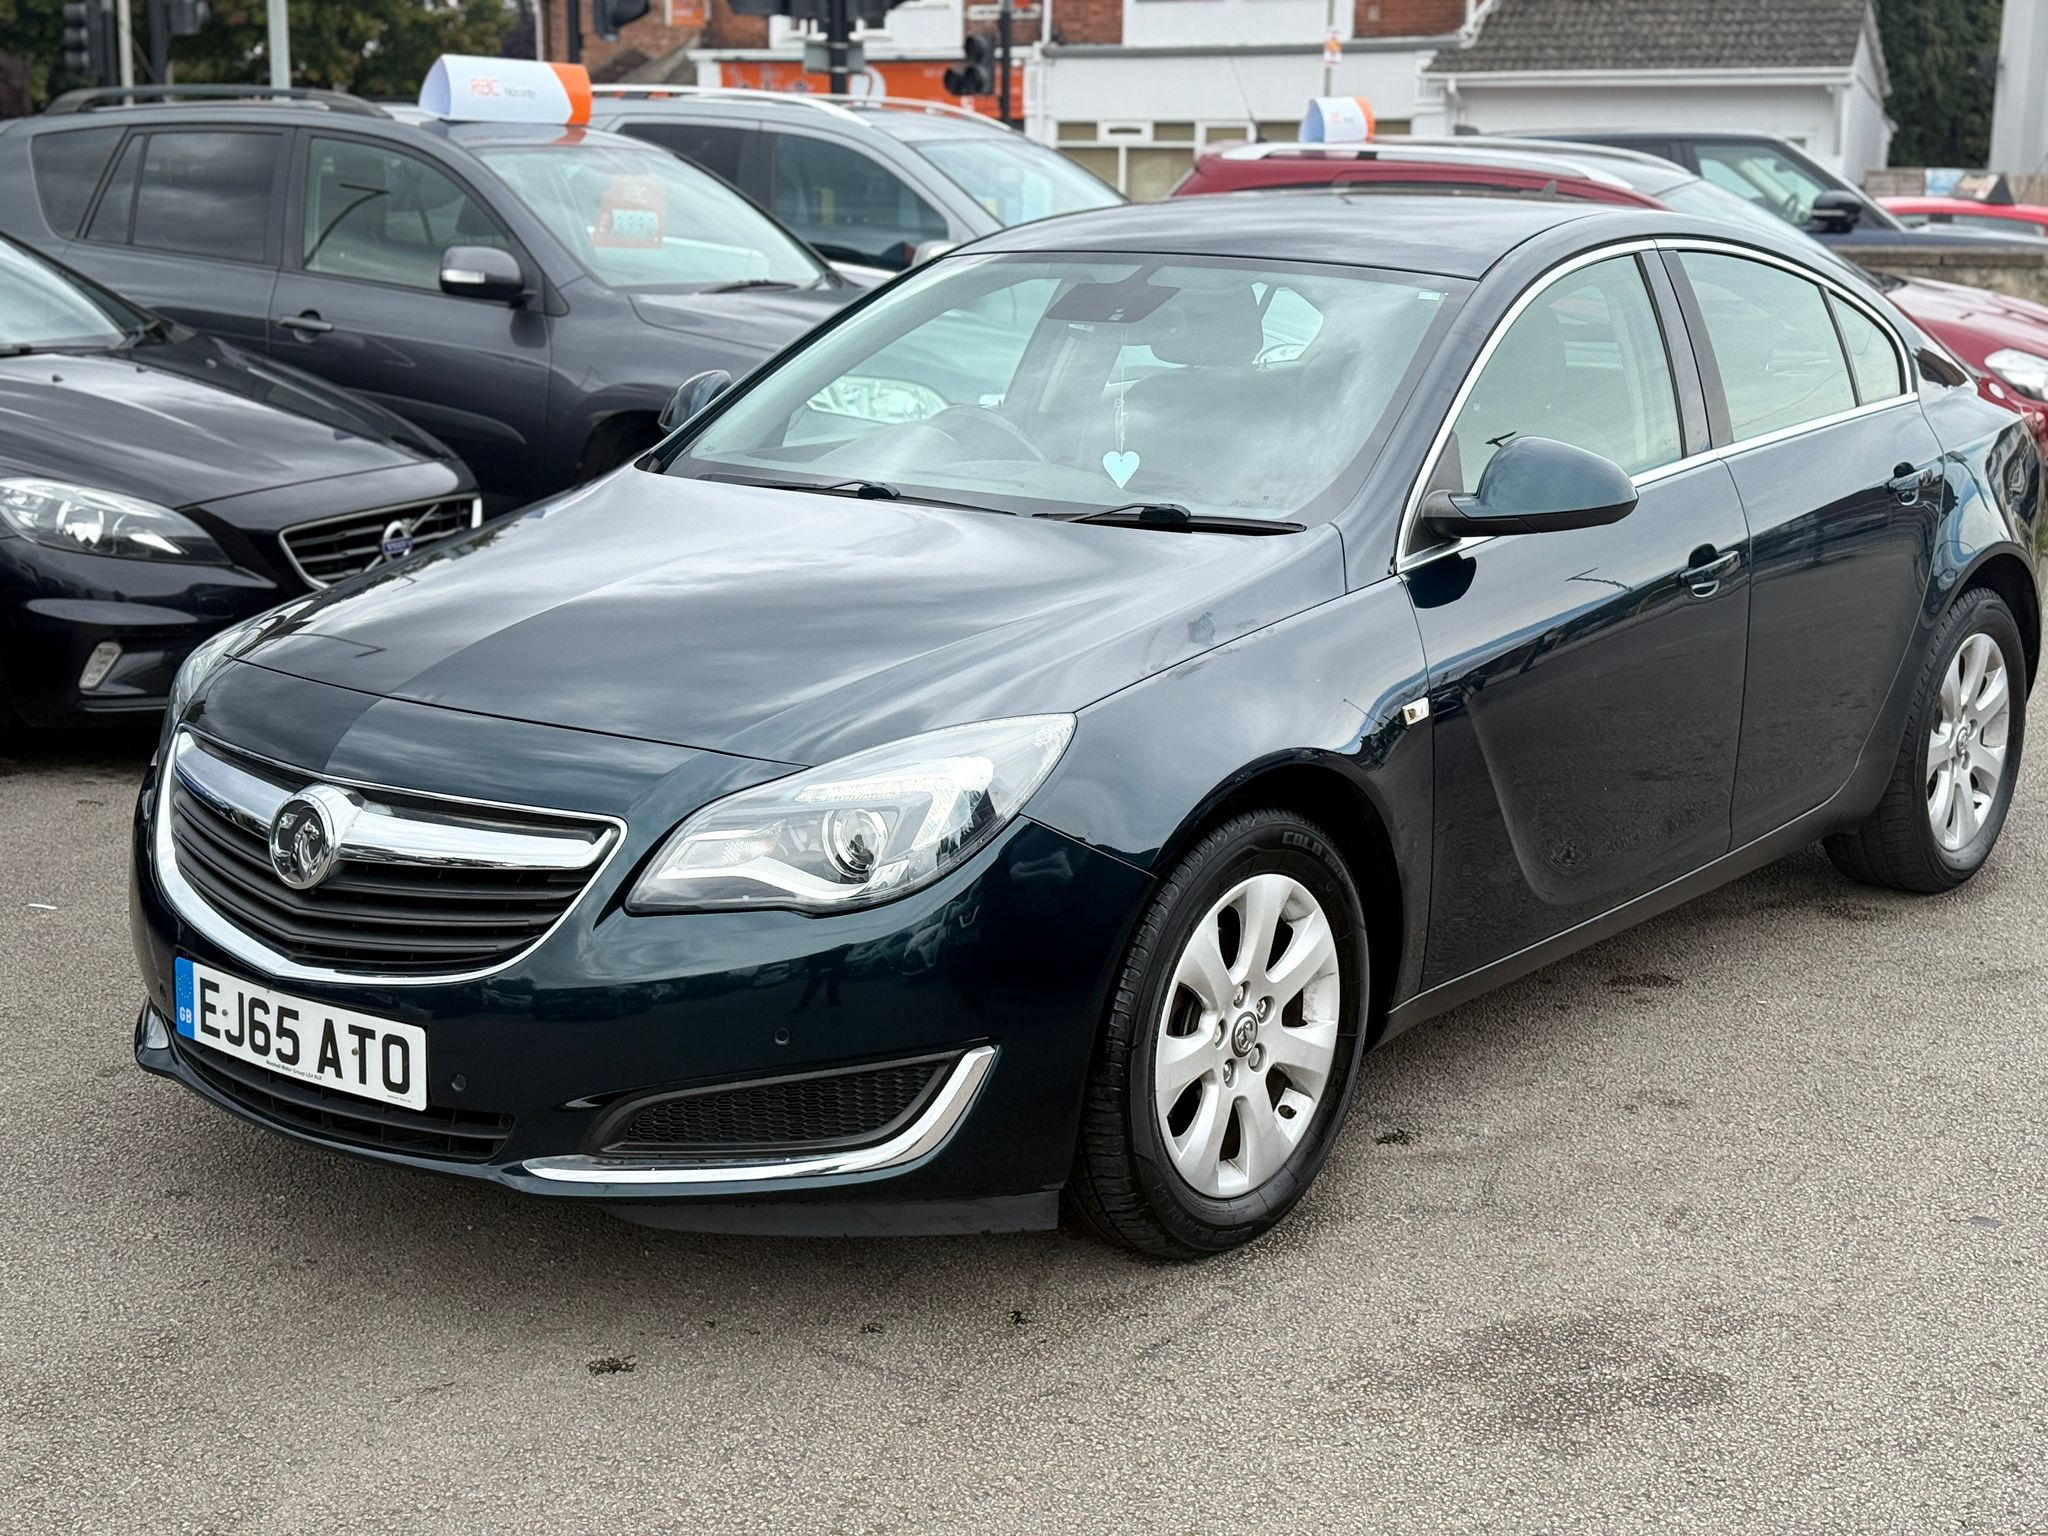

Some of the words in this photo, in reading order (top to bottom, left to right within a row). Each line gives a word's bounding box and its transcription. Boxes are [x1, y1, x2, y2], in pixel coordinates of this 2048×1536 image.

[470, 77, 501, 97] RAC
[179, 1006, 192, 1024] GB
[199, 977, 300, 1066] EJ65
[317, 1018, 411, 1095] ATO
